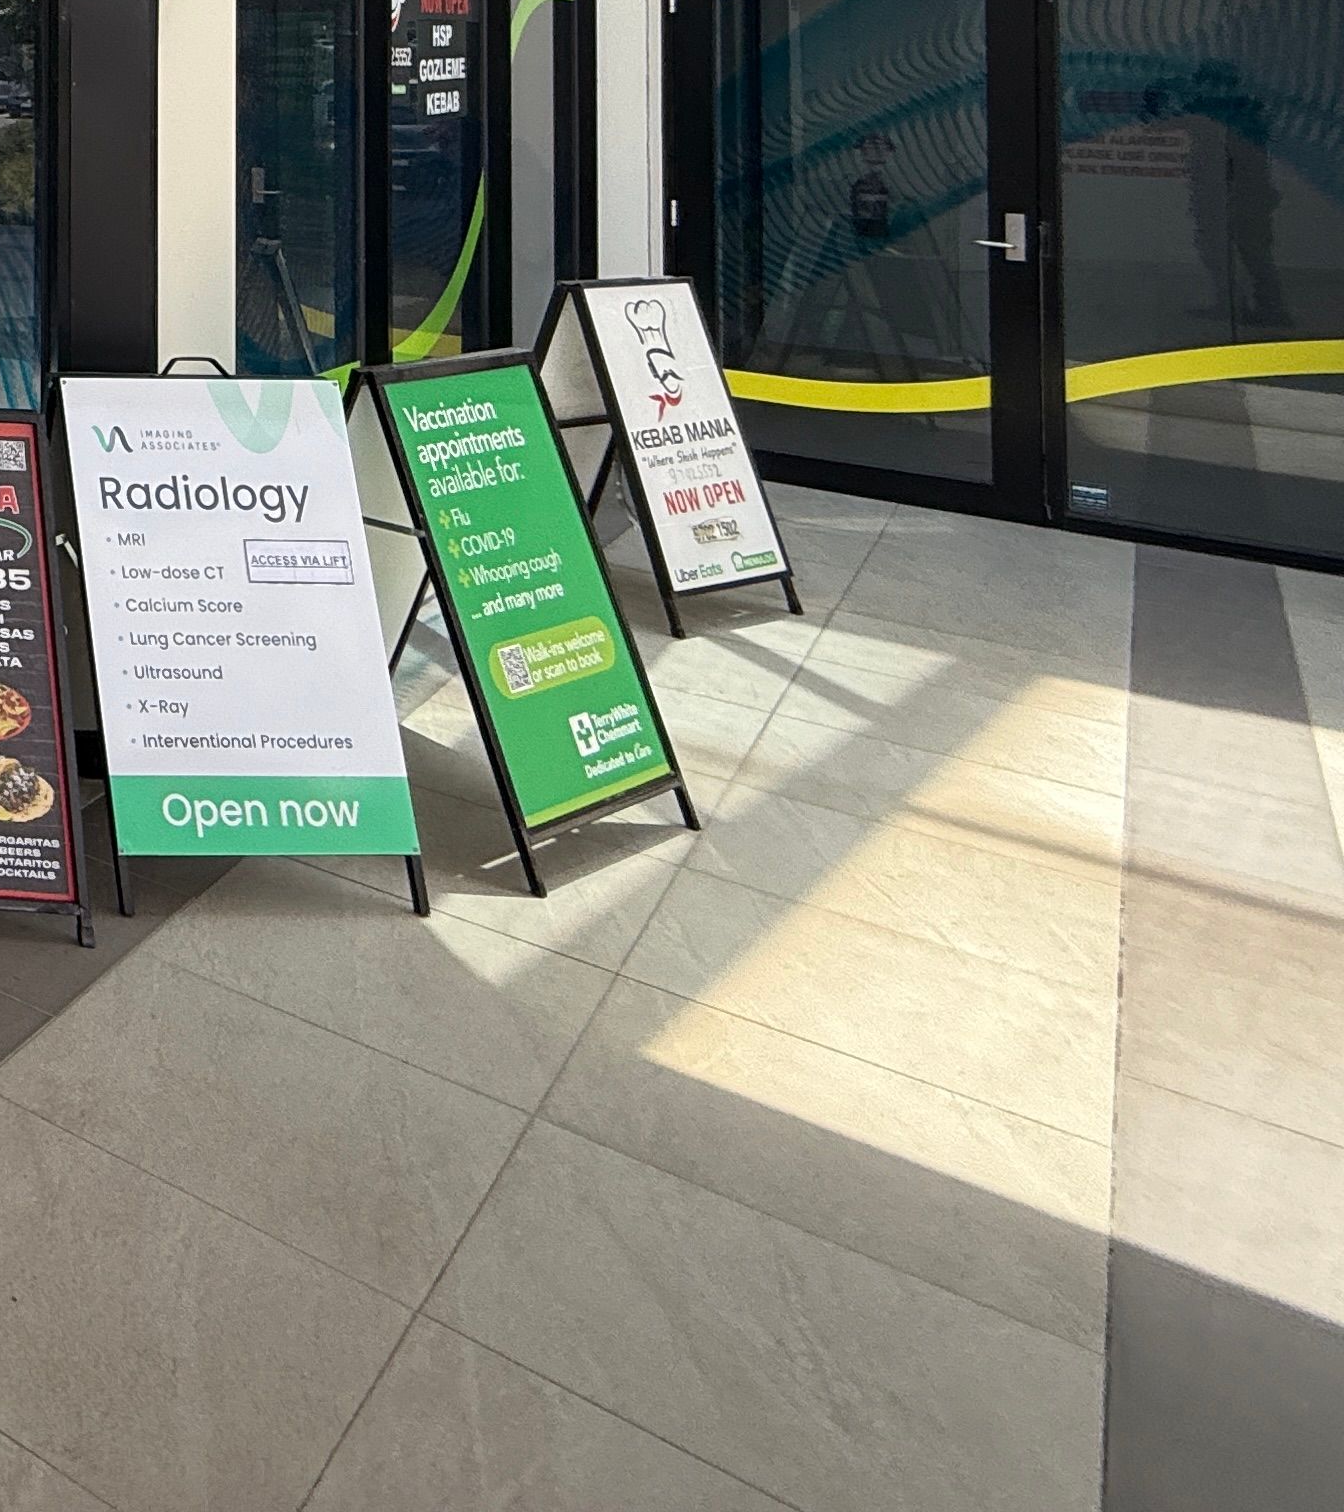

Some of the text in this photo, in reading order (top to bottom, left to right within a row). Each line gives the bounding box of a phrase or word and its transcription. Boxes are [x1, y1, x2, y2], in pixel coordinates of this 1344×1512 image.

[432, 24, 453, 47] HSP
[419, 57, 466, 82] GOZLEME
[426, 90, 460, 116] KEBAB
[403, 397, 498, 432] Vaccination
[631, 417, 736, 451] KEBAB MANIA
[417, 425, 525, 471] appointments
[428, 460, 497, 497] available
[99, 474, 309, 523] Radiology
[663, 479, 746, 516] NOW OPEN
[450, 508, 471, 528] Flu
[117, 533, 146, 546] MRI
[461, 527, 515, 557] COVID-19
[121, 566, 225, 580] Low-dose CT
[251, 555, 348, 568] ACCESS VIA LIFT
[469, 548, 562, 586] Whooping cough
[674, 562, 724, 584] Uber Eats
[125, 598, 243, 613] Calcium Score
[482, 583, 564, 616] and many more
[130, 632, 317, 651] Lung Cancer Screening
[563, 630, 606, 652] welcome
[134, 665, 223, 679] Ultrasound
[532, 647, 603, 683] or scan to book
[138, 699, 189, 717] X-Ray
[143, 733, 354, 749] Interventional Procedures
[162, 792, 359, 838] Open now
[0, 847, 41, 858] BEERS
